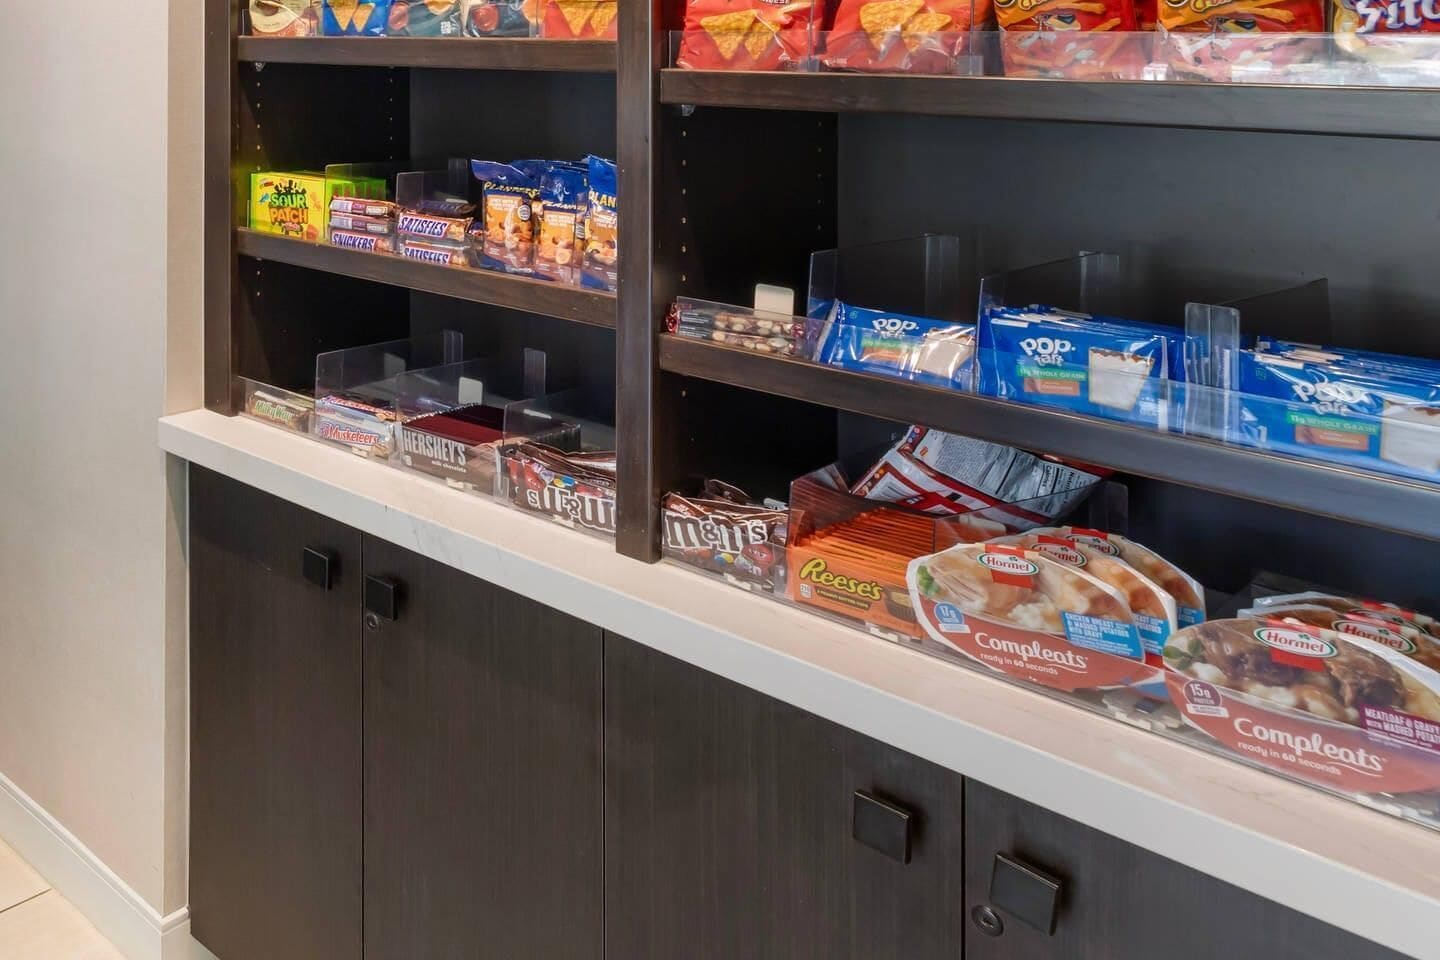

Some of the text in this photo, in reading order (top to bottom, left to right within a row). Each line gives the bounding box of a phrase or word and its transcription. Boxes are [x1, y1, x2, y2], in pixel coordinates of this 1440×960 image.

[271, 193, 307, 208] SOUR
[588, 190, 617, 208] PLAN
[270, 207, 308, 224] PATCH
[399, 217, 448, 236] SATISFIES
[332, 233, 375, 249] SNICKERS
[402, 430, 467, 465] HERSHEY'S
[986, 556, 1030, 571] Hormel
[799, 558, 882, 600] Reese's
[975, 632, 1087, 669] Compleats
[1267, 631, 1324, 653] Hormel
[980, 653, 1058, 676] ready in 60 seconds
[1189, 683, 1211, 699] 15g
[1234, 717, 1383, 771] Compleats
[1238, 742, 1341, 776] ready in 60 seconds
